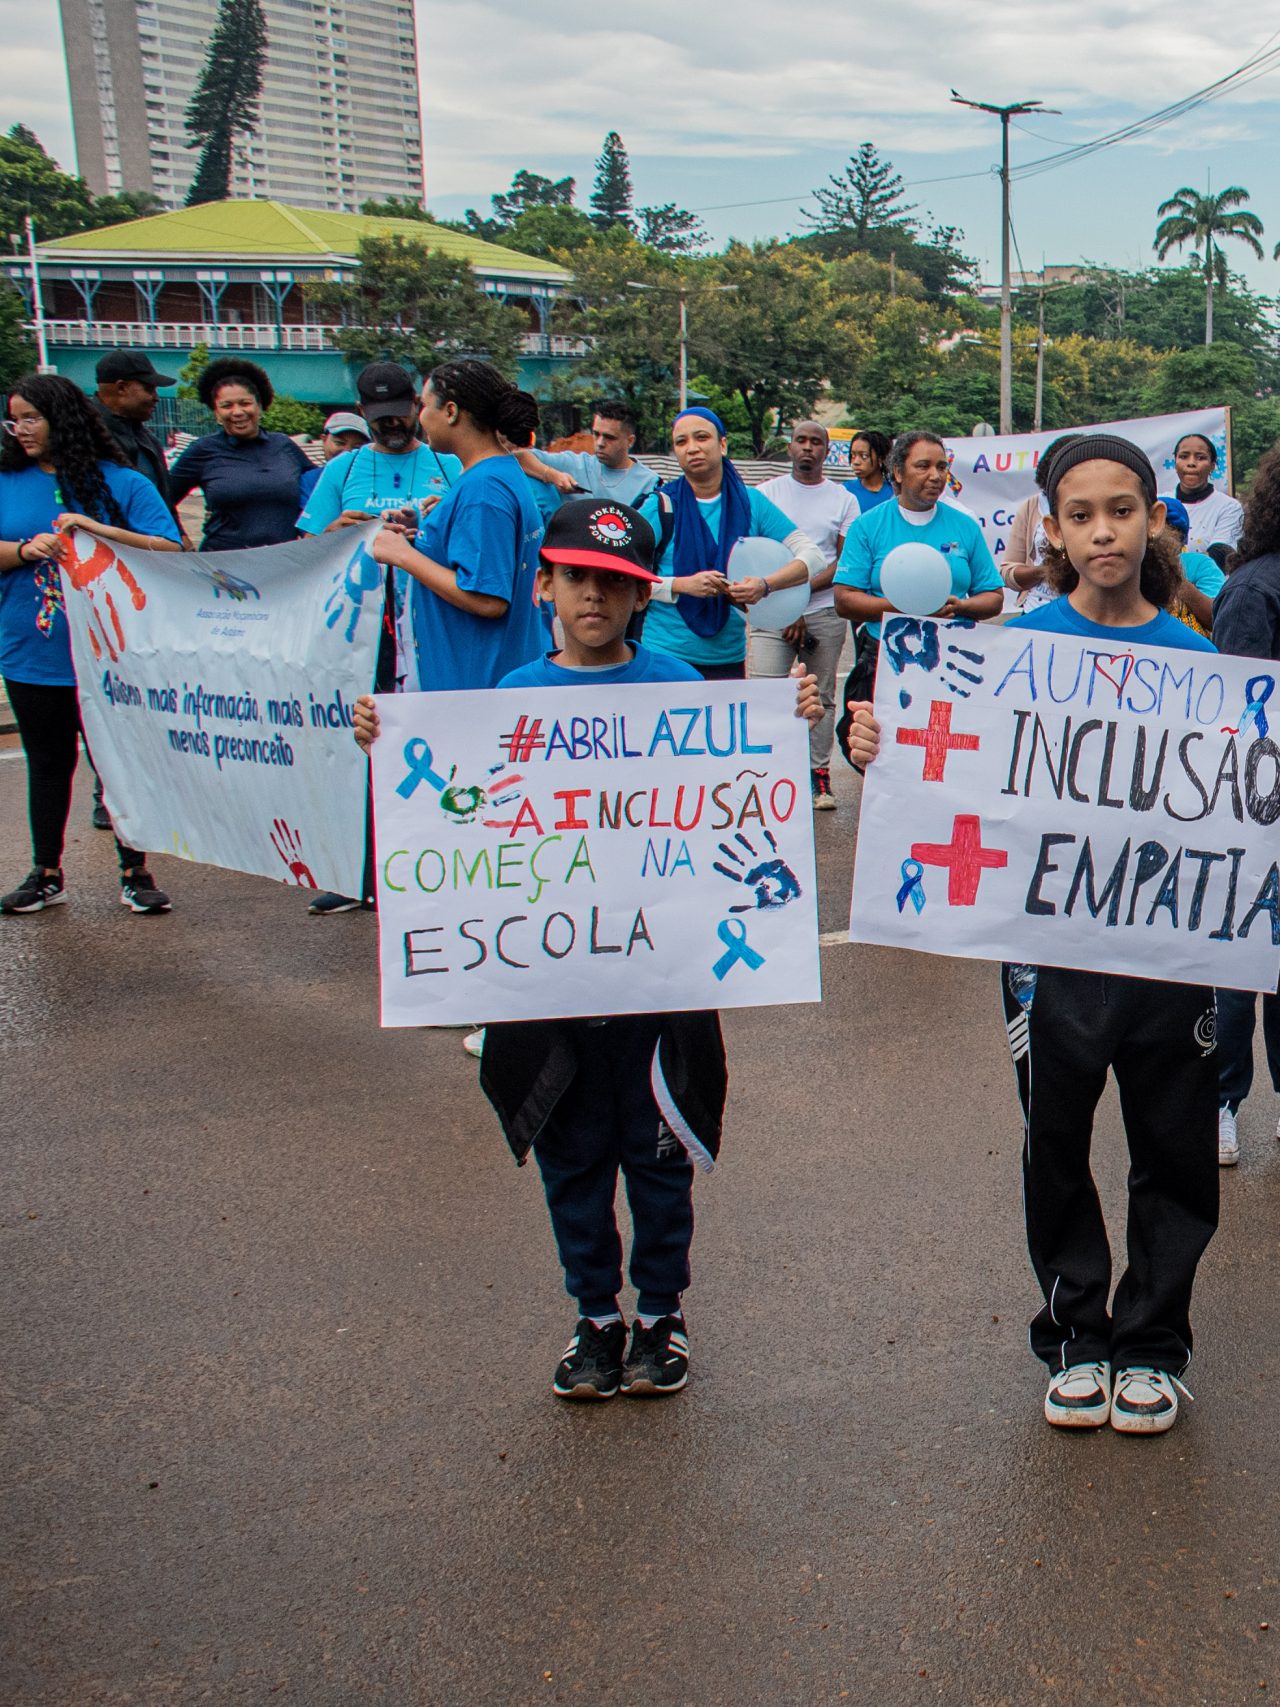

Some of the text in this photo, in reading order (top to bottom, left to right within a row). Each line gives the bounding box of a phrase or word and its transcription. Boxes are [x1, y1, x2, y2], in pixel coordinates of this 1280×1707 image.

[612, 536, 632, 547] BALL
[267, 693, 304, 728] mais
[993, 638, 1225, 726] AUTISMO
[169, 728, 294, 771] menos preconceito
[508, 769, 797, 838] A INCLUSÃO
[384, 834, 697, 903] COMEÇA NA
[404, 906, 655, 978] ESCOLA
